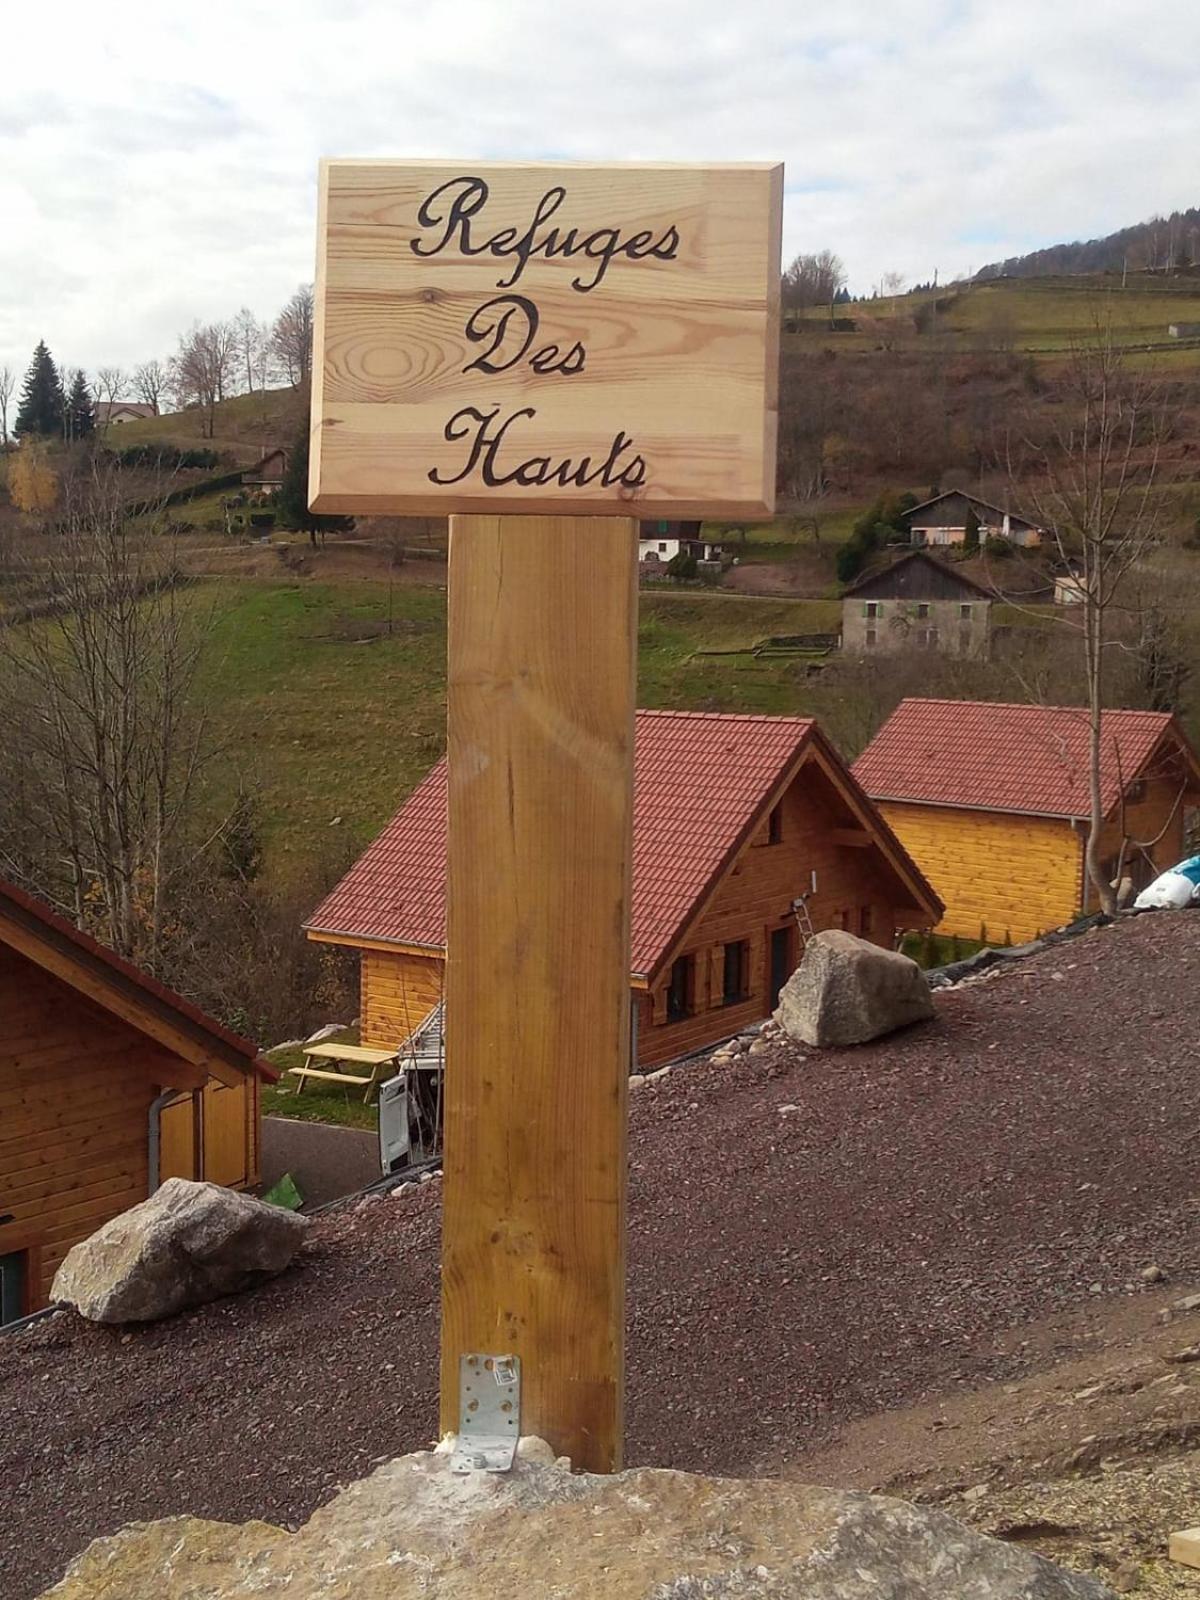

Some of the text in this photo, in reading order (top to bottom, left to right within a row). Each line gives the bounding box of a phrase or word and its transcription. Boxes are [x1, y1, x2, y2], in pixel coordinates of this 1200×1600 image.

[410, 176, 679, 292] Refuges
[462, 294, 586, 375] Des
[428, 407, 647, 487] Hauts
